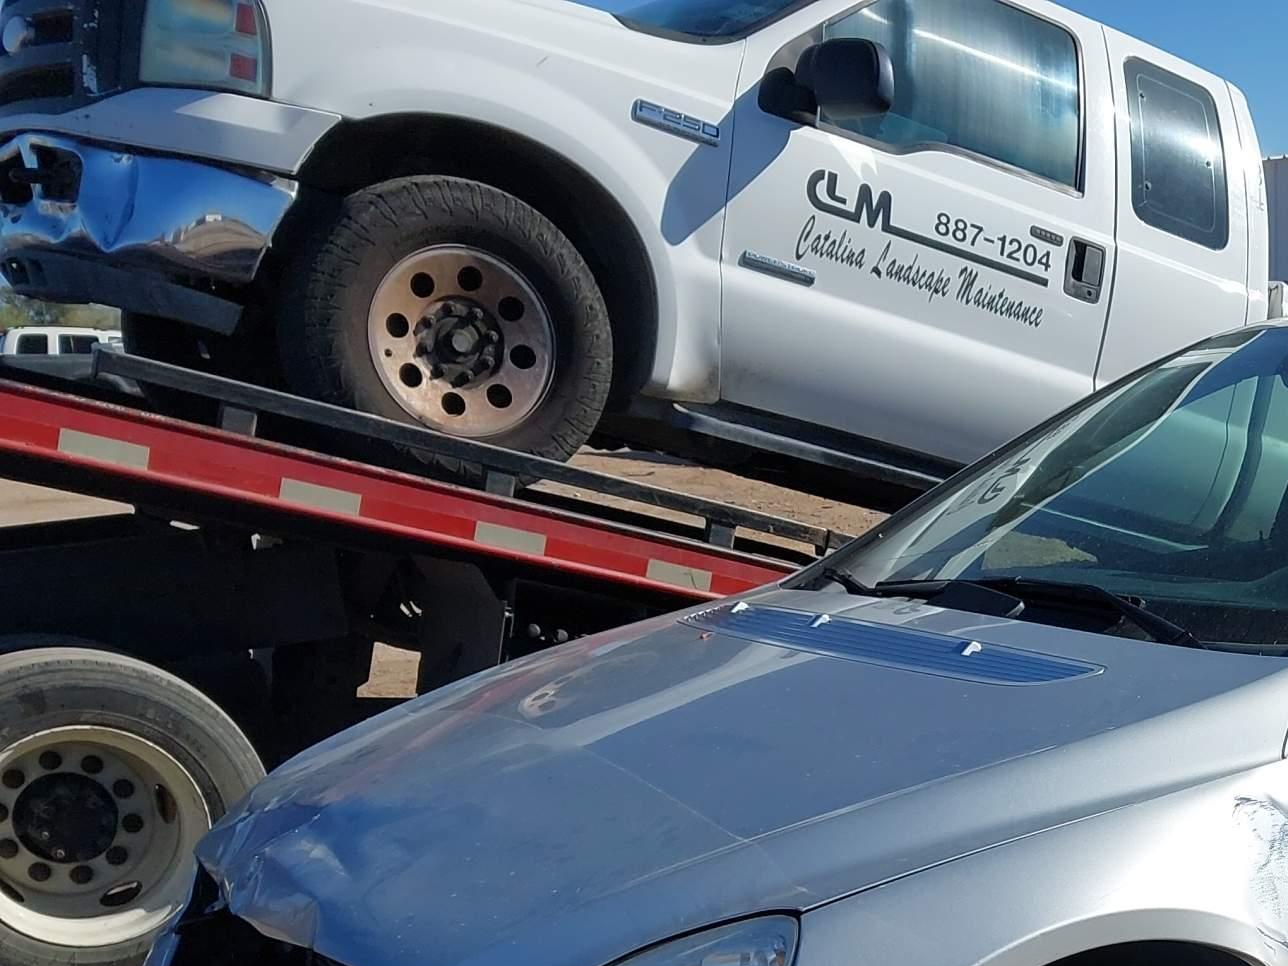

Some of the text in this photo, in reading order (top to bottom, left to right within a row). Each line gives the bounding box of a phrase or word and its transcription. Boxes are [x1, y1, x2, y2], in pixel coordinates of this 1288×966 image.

[806, 168, 893, 230] CLM
[795, 214, 866, 269] Catalina
[871, 240, 951, 303] Landscape
[957, 265, 1044, 328] Maintenance
[934, 212, 1052, 272] 887-1204
